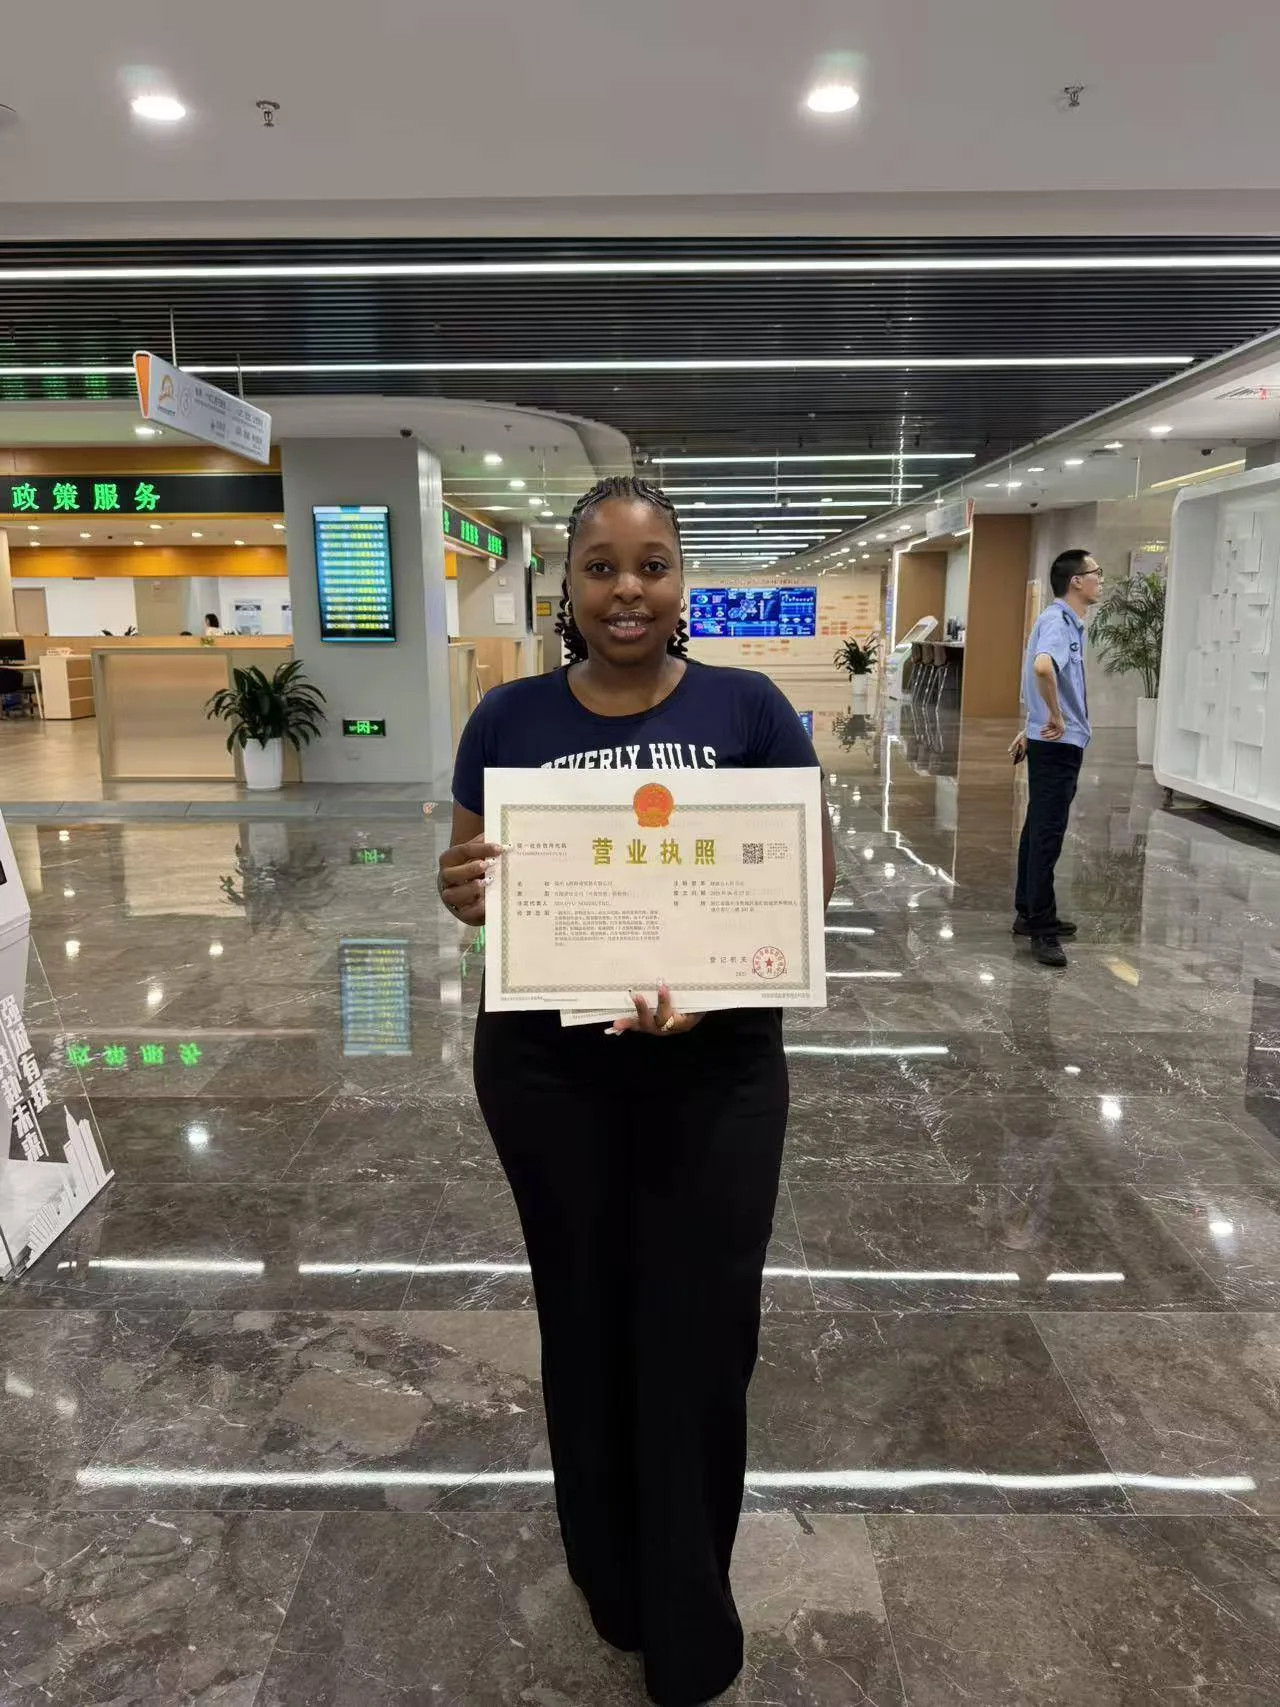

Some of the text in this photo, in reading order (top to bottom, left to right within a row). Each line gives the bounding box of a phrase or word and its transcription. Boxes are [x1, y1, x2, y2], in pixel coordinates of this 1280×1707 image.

[11, 481, 161, 511] 政策服务
[648, 742, 718, 769] HILLS
[592, 837, 716, 865] 营业执照
